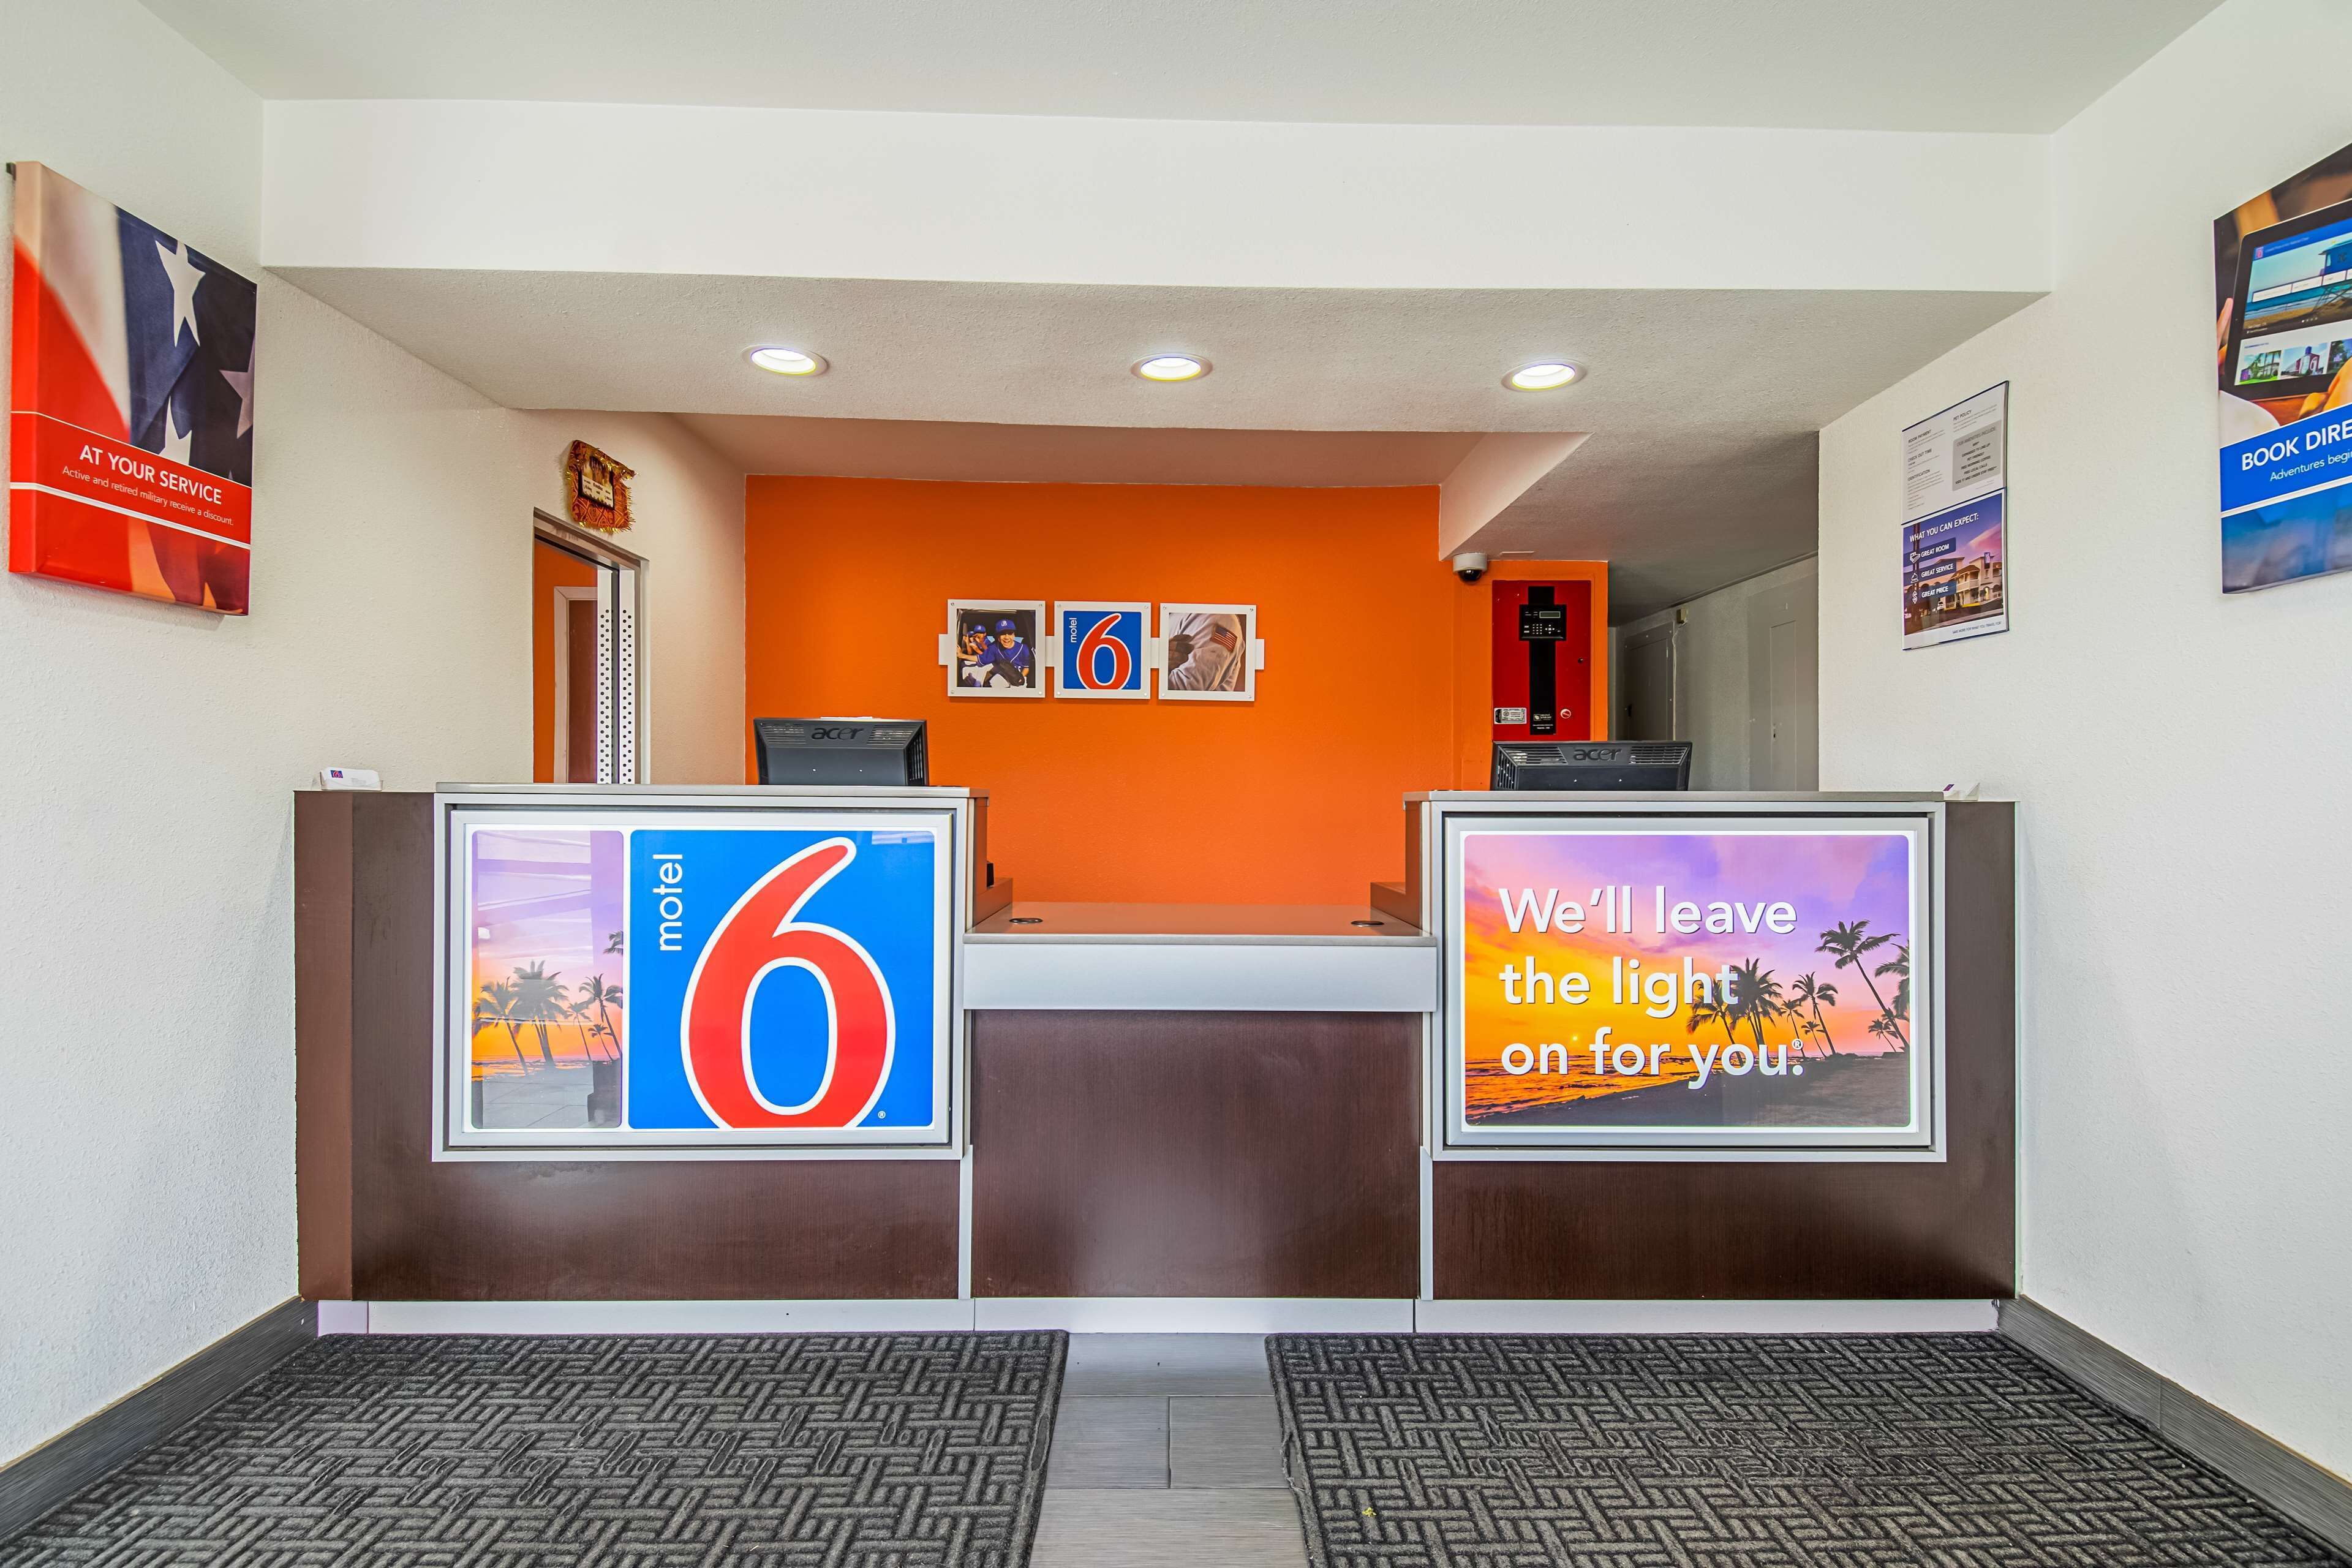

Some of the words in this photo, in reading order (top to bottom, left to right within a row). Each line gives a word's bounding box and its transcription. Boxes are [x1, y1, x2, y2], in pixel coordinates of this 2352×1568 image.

[2242, 437, 2299, 470] BOOK
[2269, 459, 2325, 481] Adventures
[79, 445, 103, 465] AT
[108, 452, 155, 483] YOUR
[159, 470, 222, 505] SERVICE
[62, 466, 90, 482] Active
[93, 475, 108, 488] and
[111, 481, 138, 496] retired
[140, 491, 168, 507] military
[170, 500, 195, 514] receive
[203, 510, 234, 526] discount.
[1909, 531, 1925, 542] WHAT
[1926, 527, 1939, 537] YOU
[1939, 521, 1953, 532] CAN
[1954, 513, 1979, 527] EXPECT:
[1921, 548, 1934, 557] GREAT
[1936, 544, 1949, 552] ROOM
[1921, 569, 1935, 578] GREAT
[1936, 564, 1953, 574] SERVICE
[1936, 586, 1948, 594] PRICE
[1076, 613, 1132, 690] 6
[811, 726, 864, 740] acer
[1573, 748, 1622, 761] acer
[1499, 884, 1634, 935] We’ll
[1656, 884, 1797, 934] leave
[653, 853, 682, 951] motel
[680, 837, 895, 1129] 6
[1499, 956, 1591, 1005] the
[1613, 956, 1740, 1019] light
[1501, 1042, 1569, 1076] on
[1589, 1026, 1671, 1076] for
